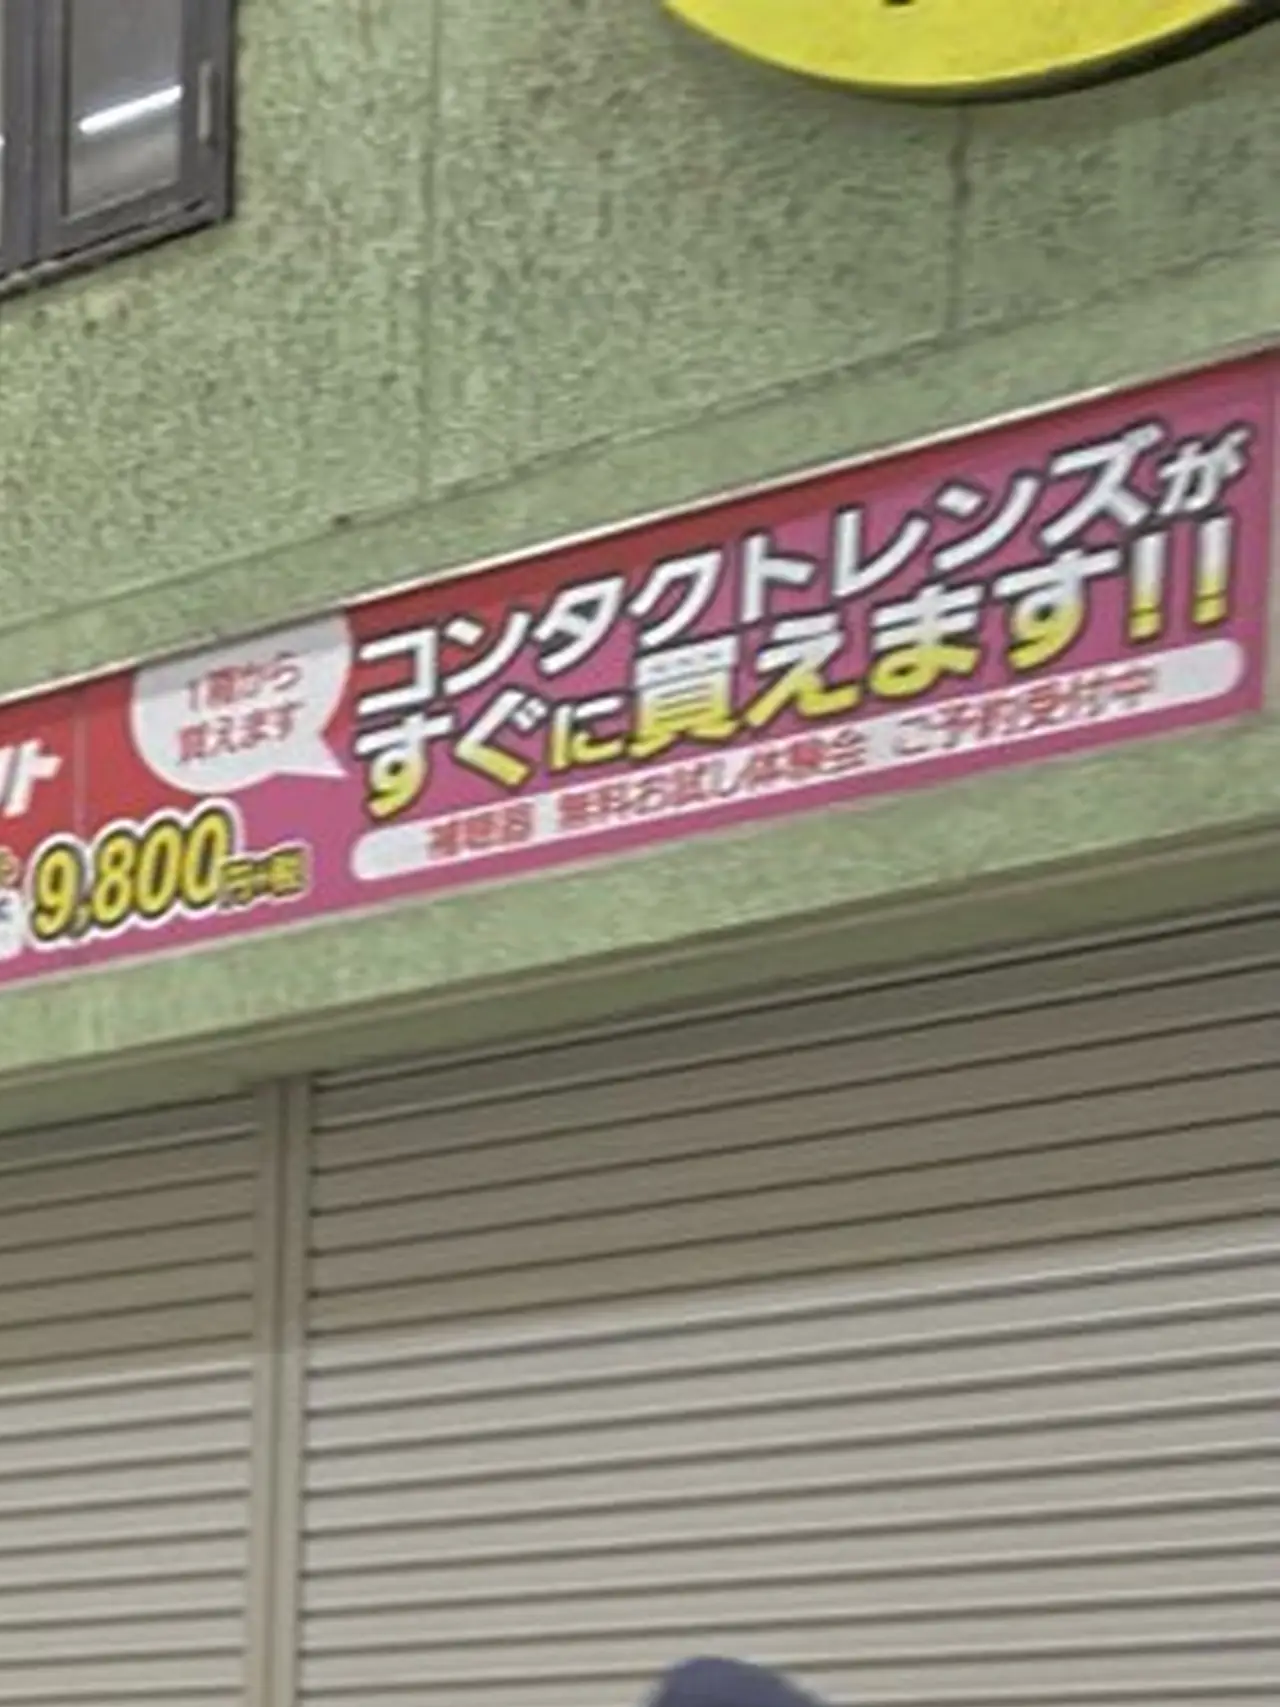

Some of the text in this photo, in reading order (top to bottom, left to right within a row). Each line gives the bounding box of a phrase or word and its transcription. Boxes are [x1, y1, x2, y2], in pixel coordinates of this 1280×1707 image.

[357, 423, 1250, 716] コンタクトレンズが
